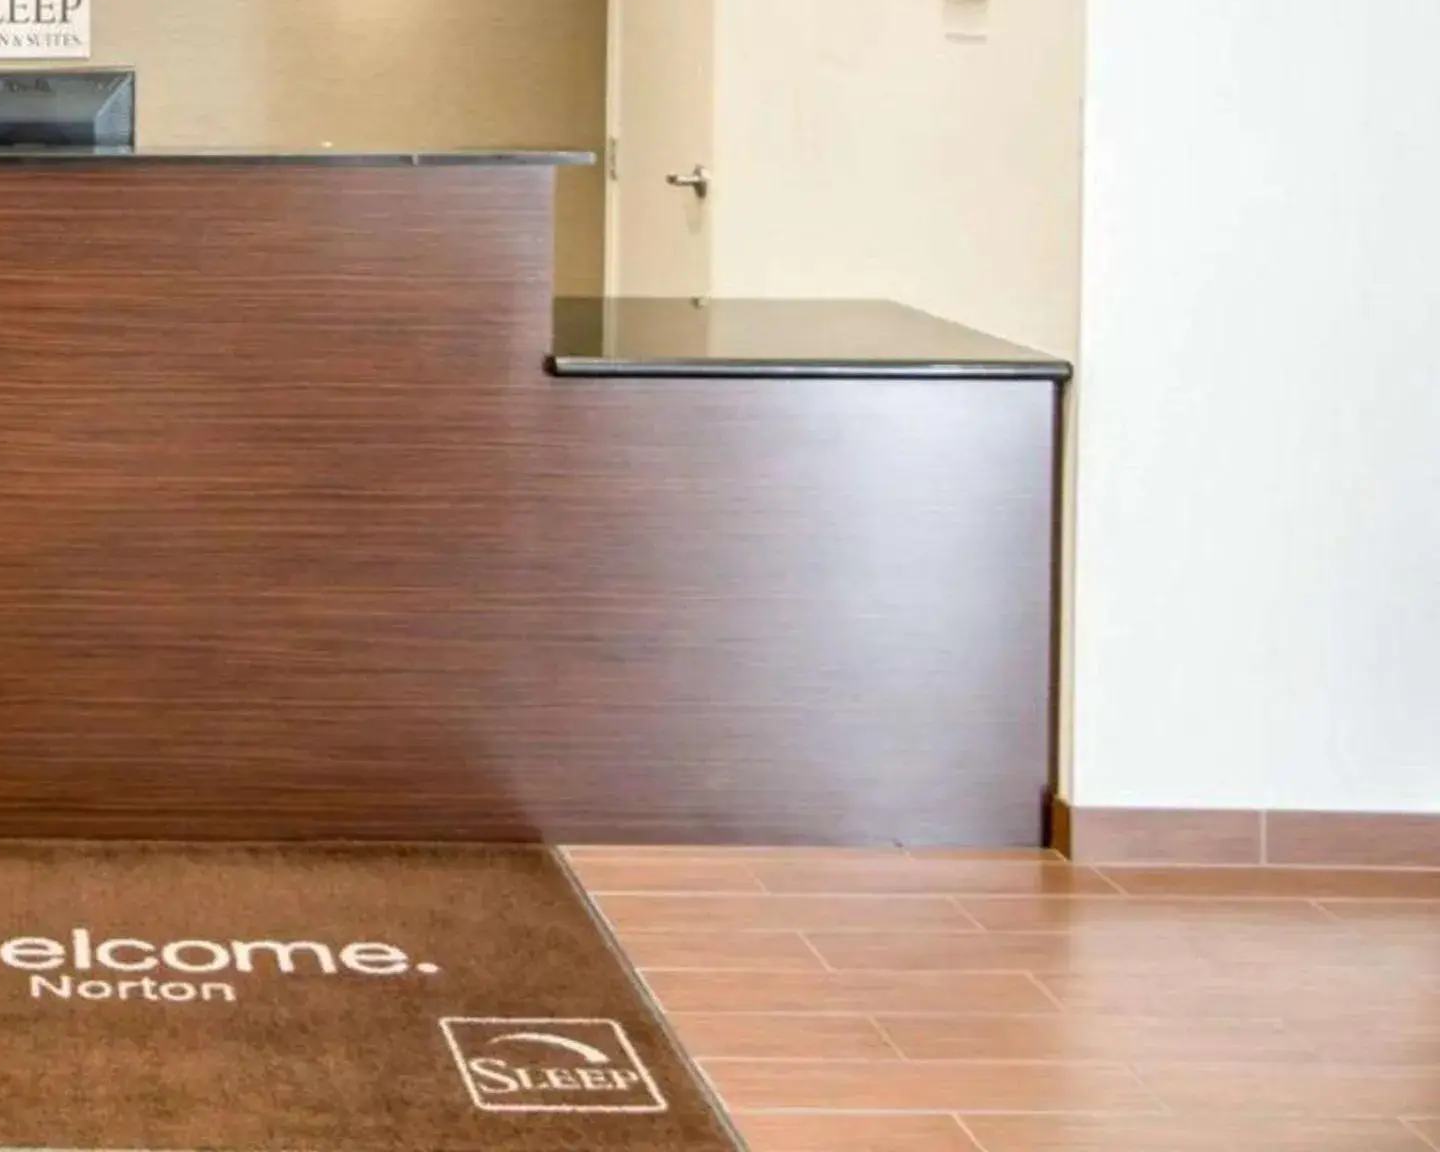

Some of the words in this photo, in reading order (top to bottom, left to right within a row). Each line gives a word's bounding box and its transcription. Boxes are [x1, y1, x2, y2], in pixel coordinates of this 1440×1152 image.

[12, 35, 23, 47] &
[26, 33, 82, 47] SUITES
[30, 973, 237, 1002] Norton
[468, 1057, 639, 1093] SLEEP
